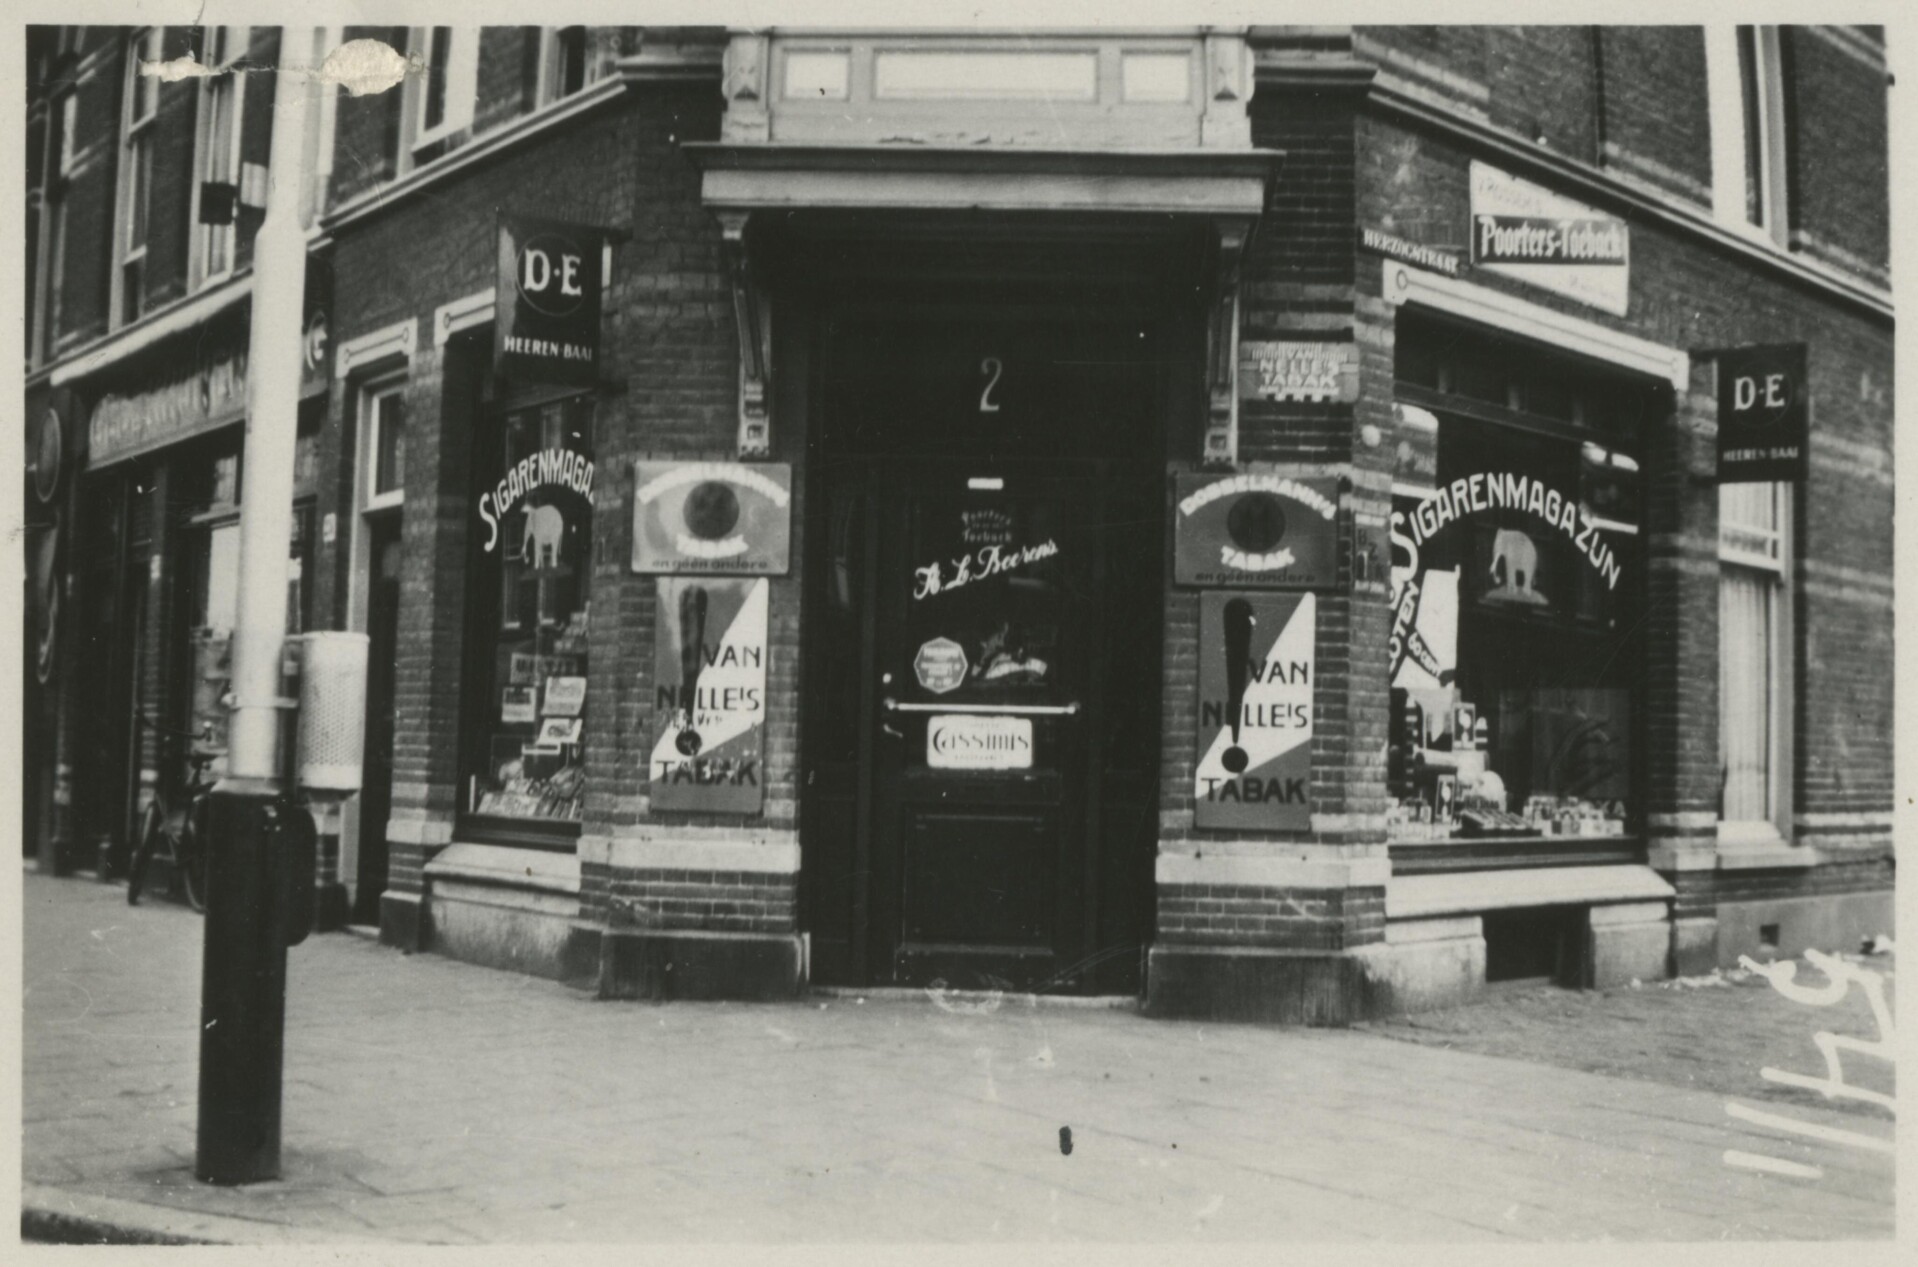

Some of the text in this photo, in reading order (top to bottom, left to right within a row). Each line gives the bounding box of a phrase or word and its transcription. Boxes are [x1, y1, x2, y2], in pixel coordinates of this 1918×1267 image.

[980, 357, 1002, 411] 2
[704, 645, 760, 668] VAN
[1250, 660, 1308, 684] VAN
[655, 759, 758, 786] TABAK
[1200, 777, 1307, 804] TABAK
